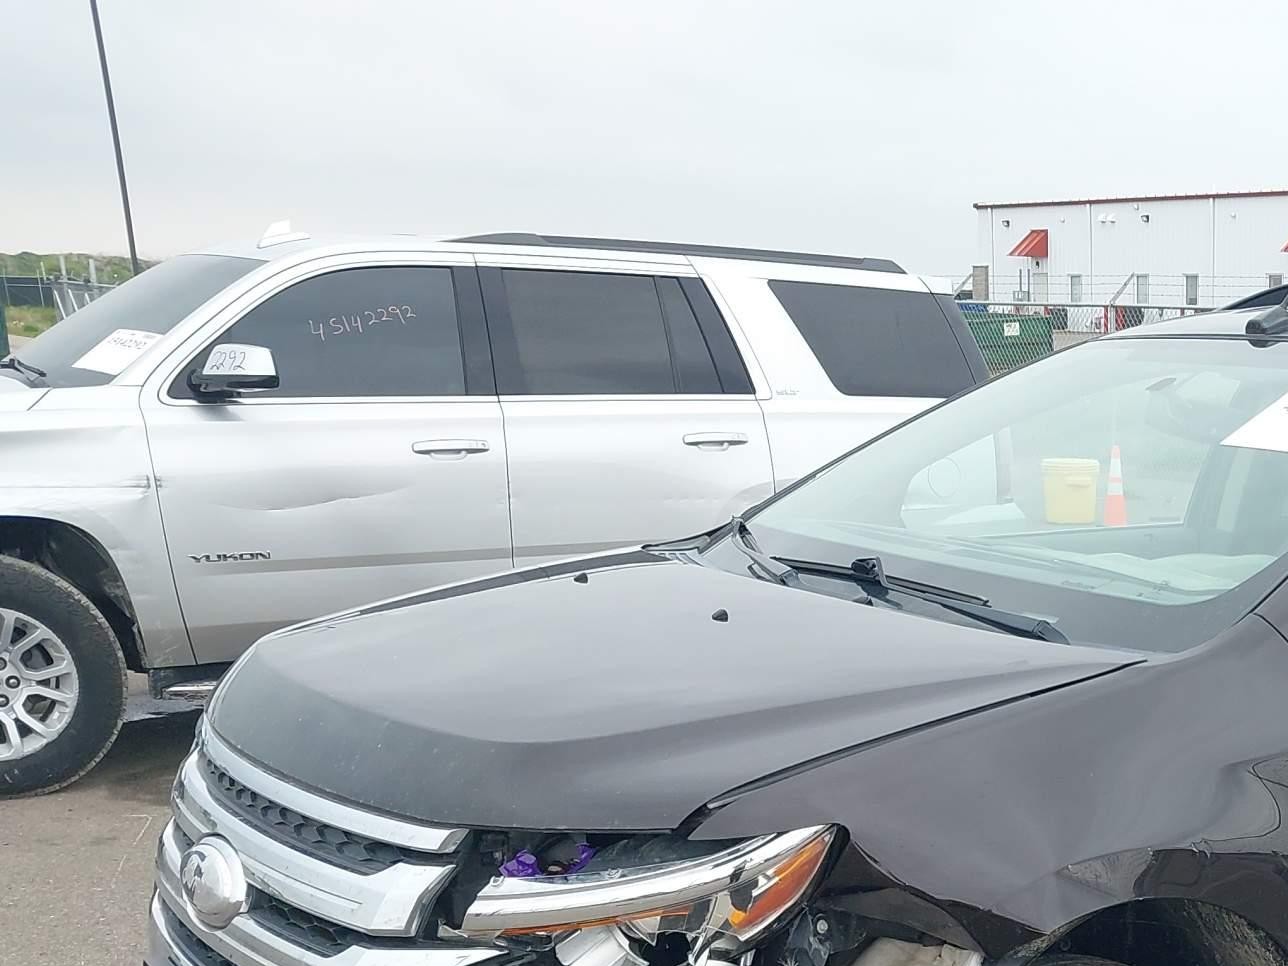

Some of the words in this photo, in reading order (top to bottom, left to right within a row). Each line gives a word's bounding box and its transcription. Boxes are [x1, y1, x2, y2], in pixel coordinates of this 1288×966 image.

[308, 305, 417, 341] 45142292
[209, 350, 246, 371] 2292
[187, 551, 271, 563] YUKON
